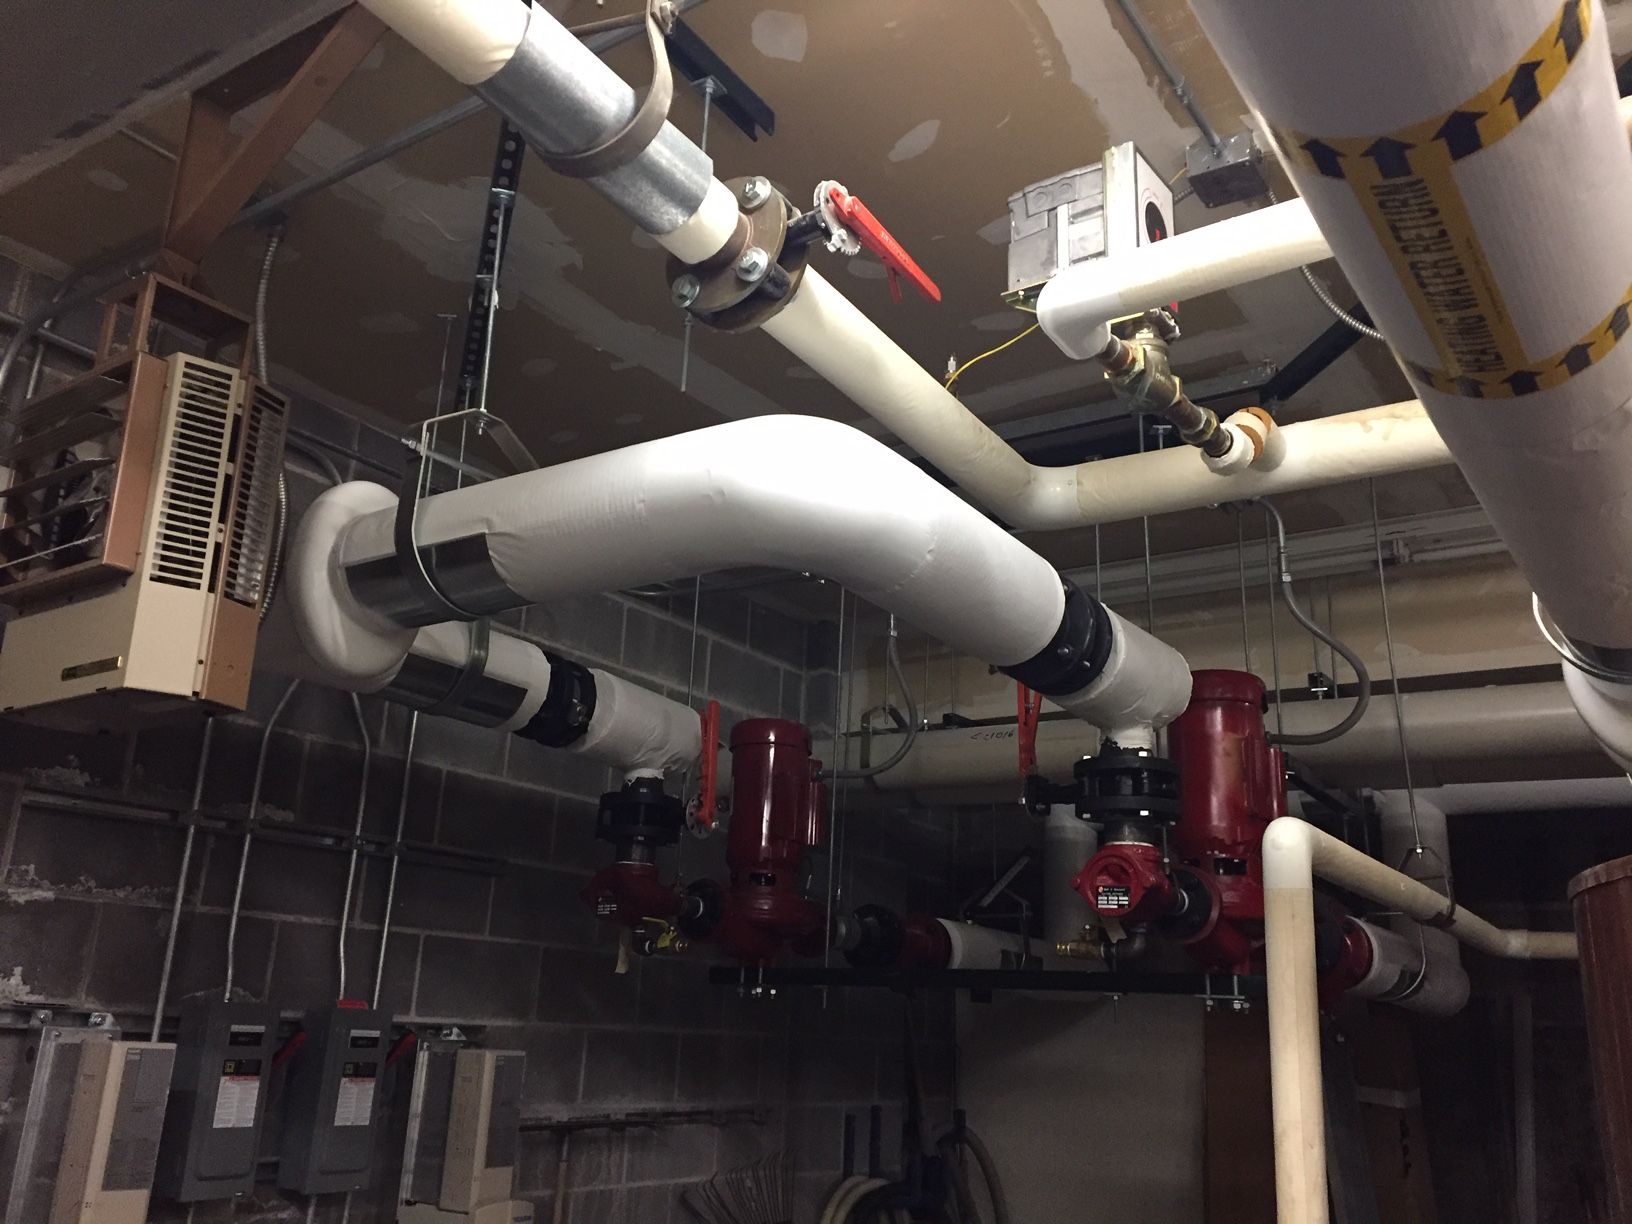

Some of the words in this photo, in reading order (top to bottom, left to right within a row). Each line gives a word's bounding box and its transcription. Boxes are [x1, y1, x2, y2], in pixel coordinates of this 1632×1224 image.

[1370, 178, 1454, 254] RETURN
[1409, 256, 1479, 313] WATER
[1437, 314, 1506, 373] HEATING
